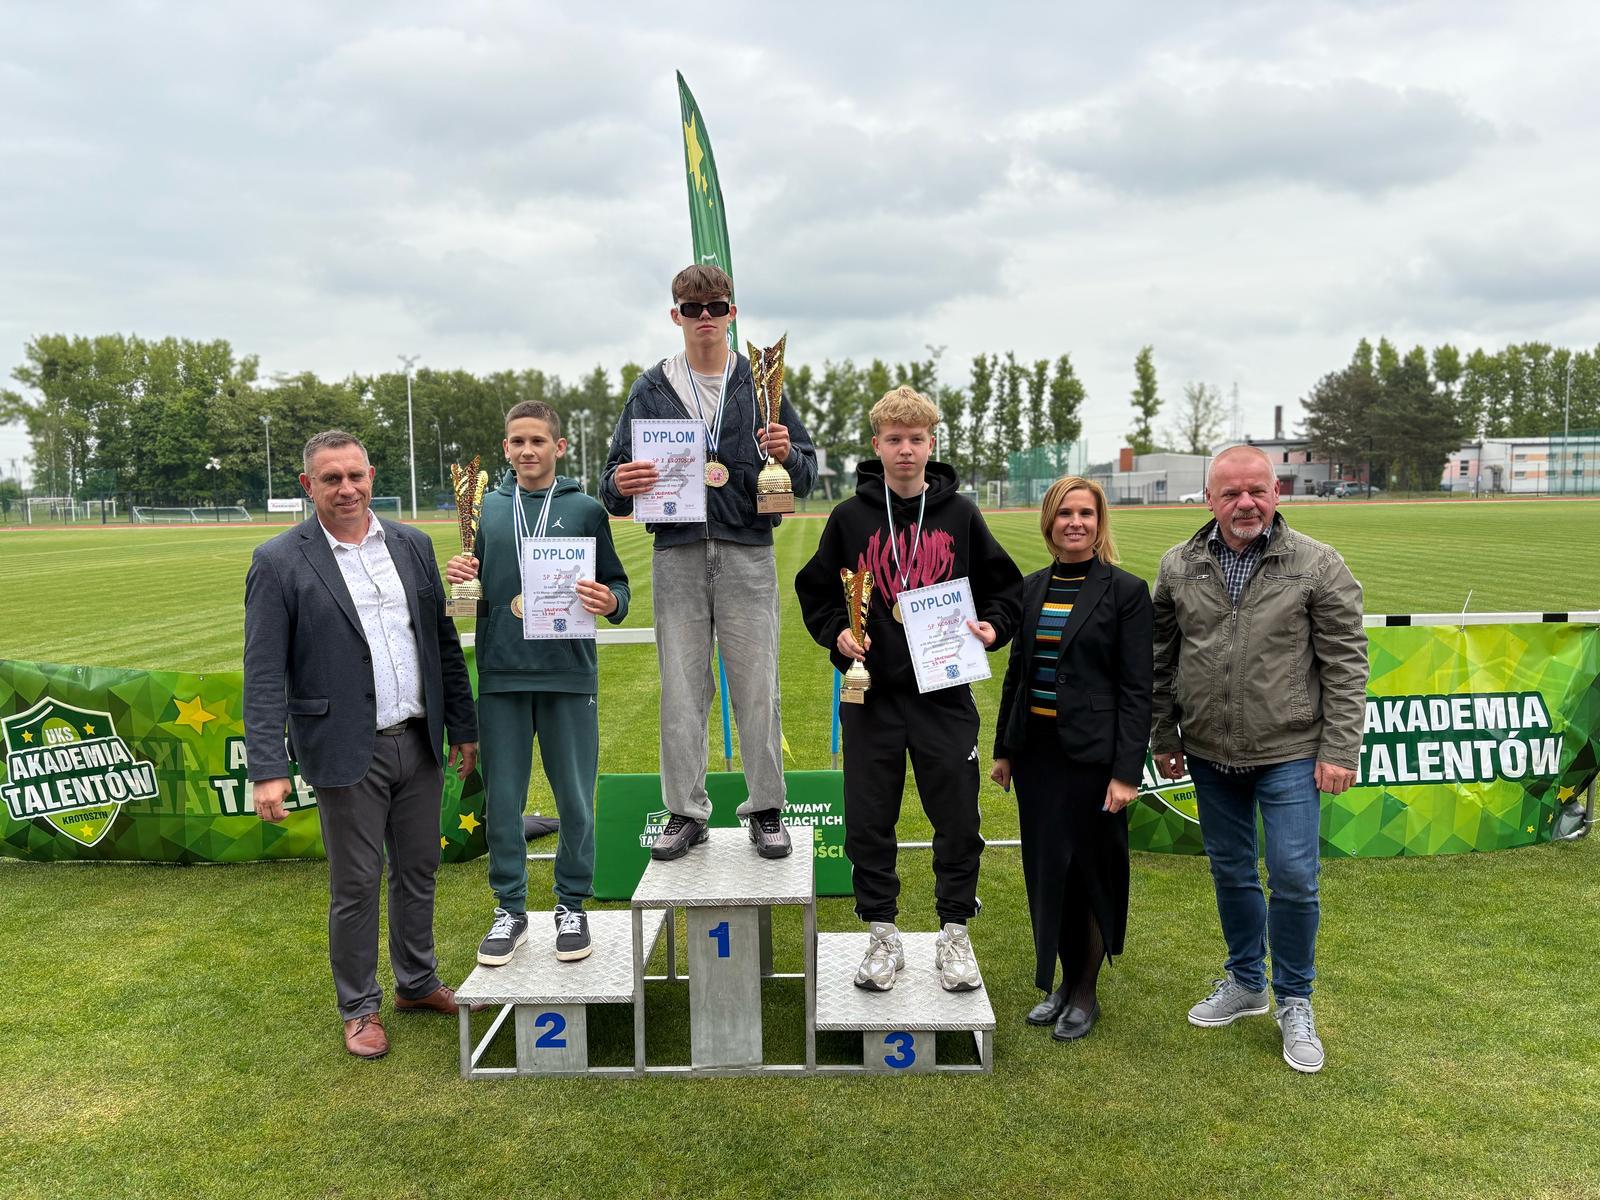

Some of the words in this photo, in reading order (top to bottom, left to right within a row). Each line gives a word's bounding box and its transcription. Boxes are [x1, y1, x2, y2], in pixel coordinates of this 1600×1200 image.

[643, 431, 695, 443] DYPLOM
[533, 549, 585, 560] DYPLOM
[910, 591, 962, 613] DYPLOM
[1363, 696, 1549, 734] AKADEMIA
[45, 726, 74, 744] UKS
[11, 741, 130, 781] AKADEMIA
[5, 766, 154, 815] TALENTÓW
[62, 811, 109, 825] KROTOSZYN
[822, 815, 843, 826] ICH
[708, 921, 731, 958] 1
[535, 1012, 567, 1048] 2
[883, 1031, 916, 1069] 3
